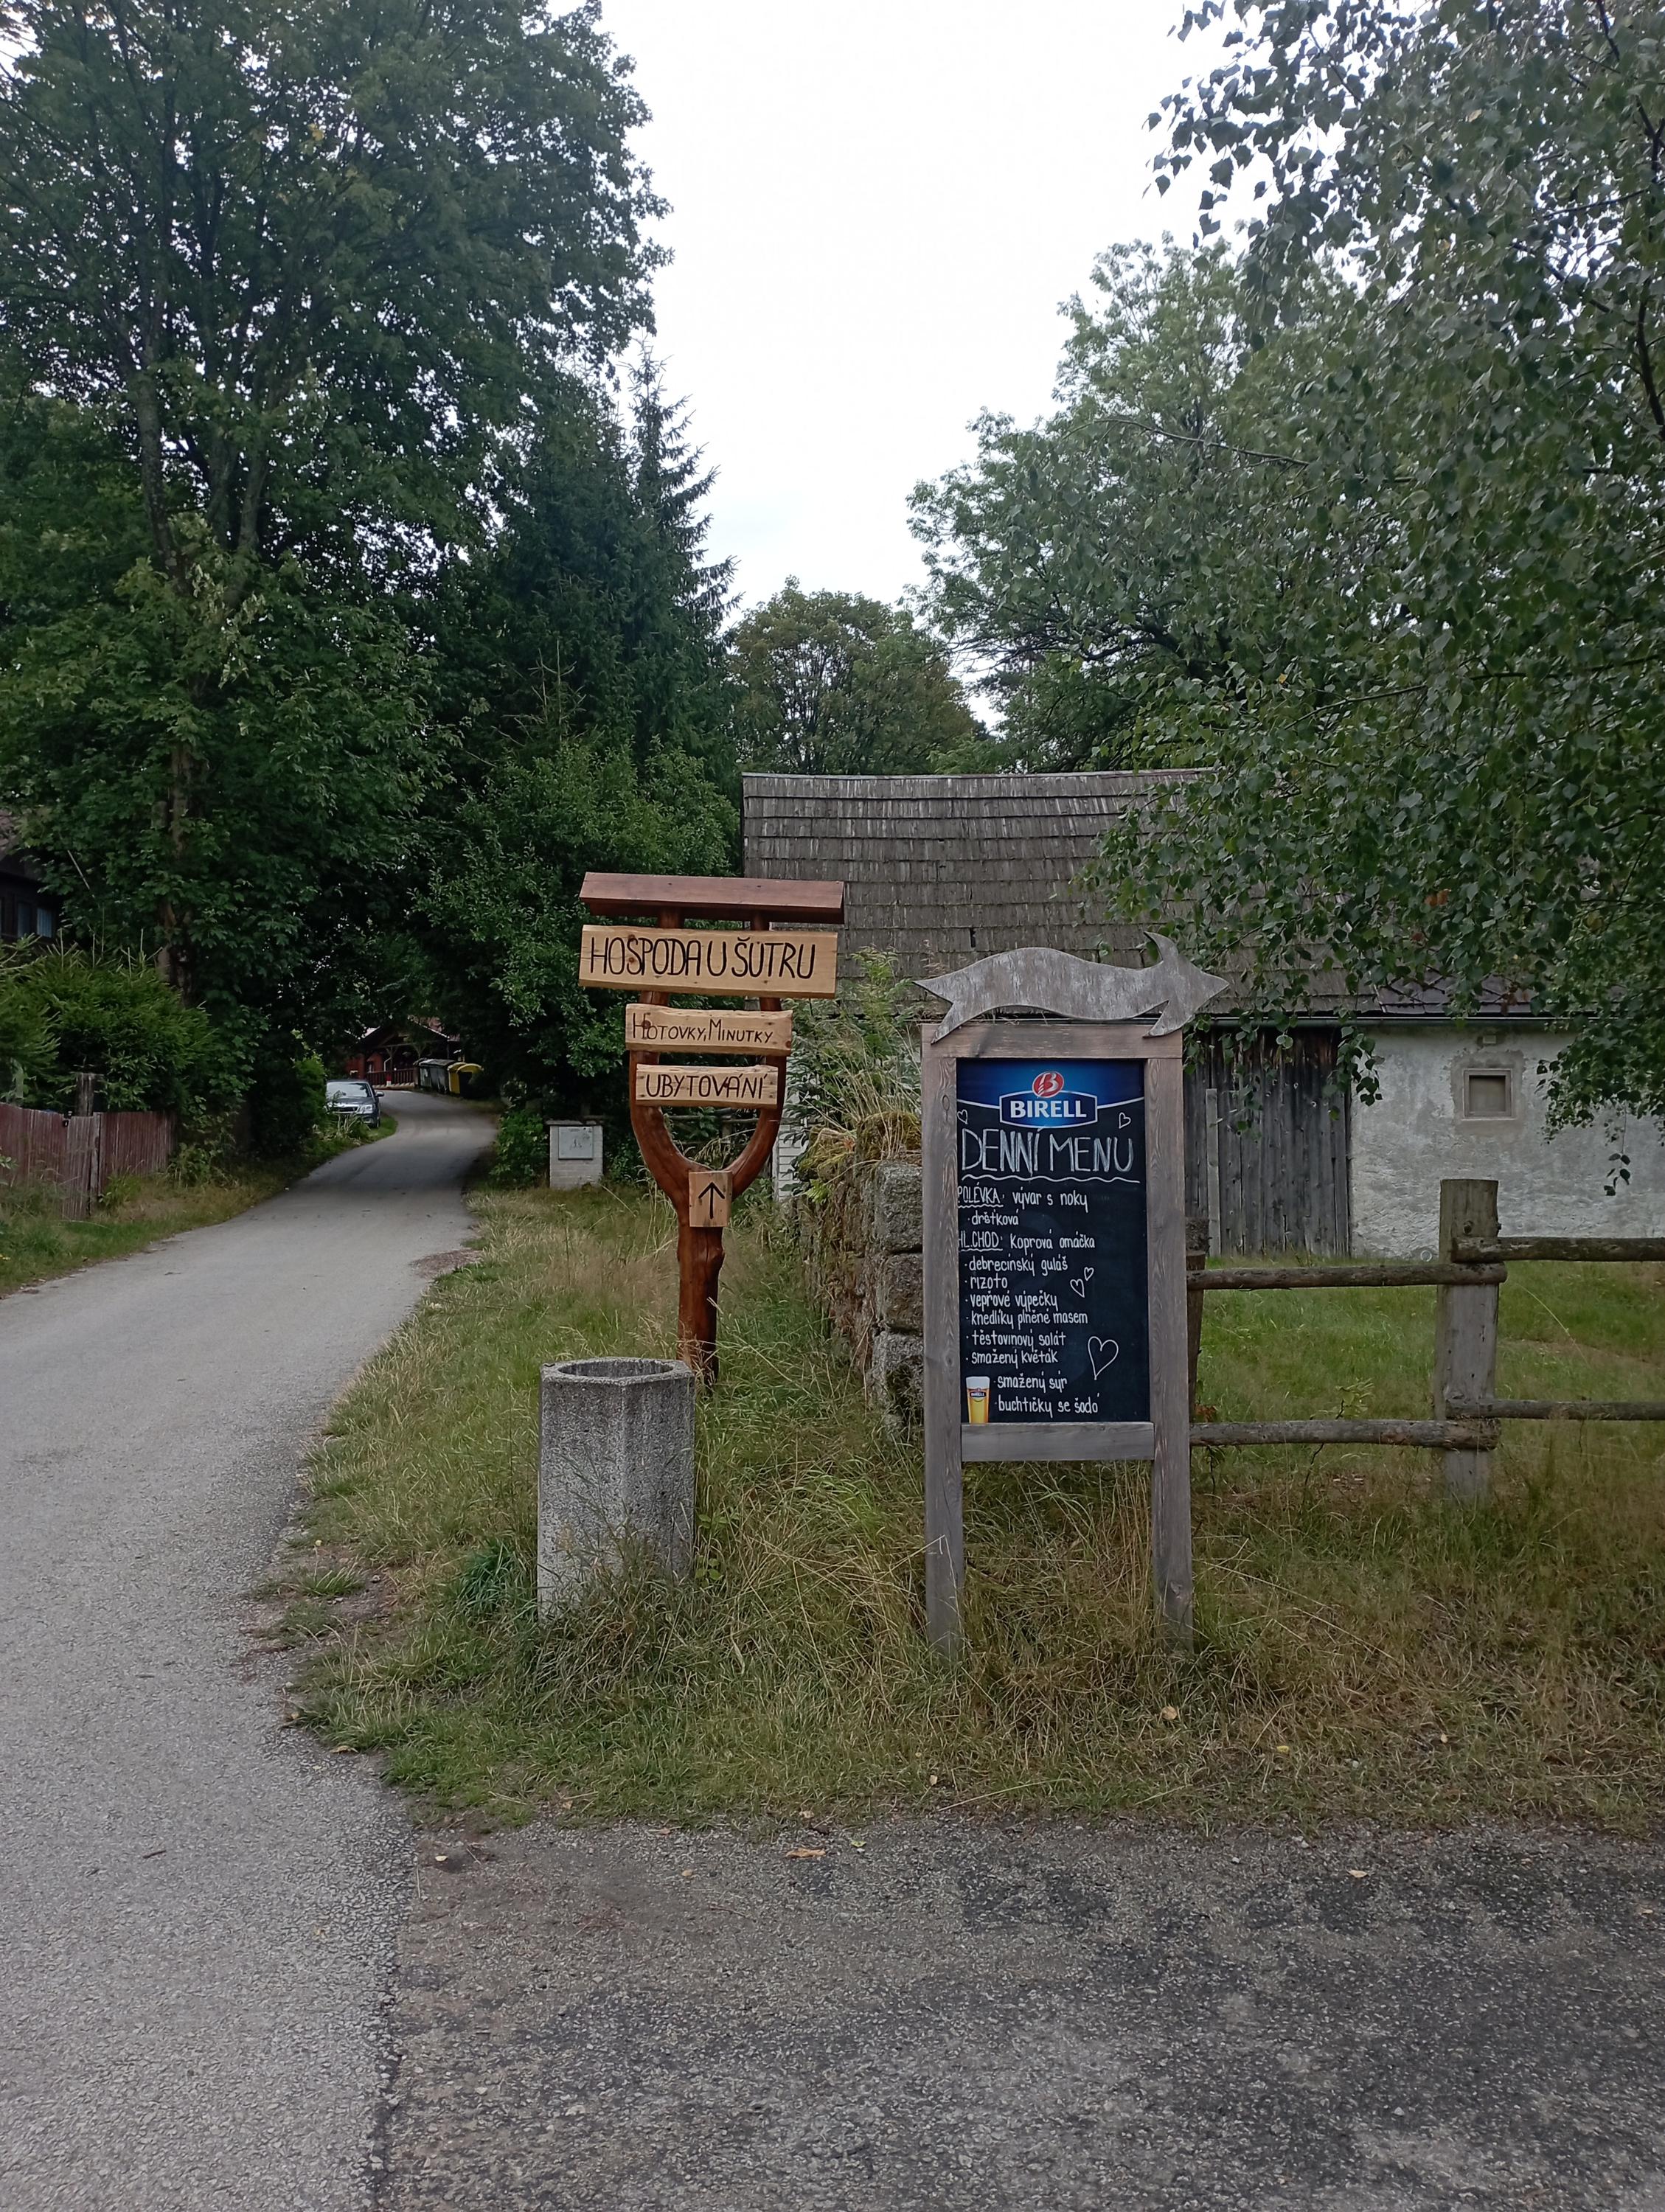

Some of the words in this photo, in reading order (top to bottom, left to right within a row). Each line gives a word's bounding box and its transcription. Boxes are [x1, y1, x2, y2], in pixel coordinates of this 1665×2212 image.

[591, 936, 701, 975] HOSPODA
[706, 940, 726, 977] U
[731, 936, 816, 979] ŠUTRU
[708, 1018, 774, 1043] MINUTKY
[646, 1074, 768, 1099] UBYTOVÁNÍ
[1010, 1100, 1087, 1119] BIRELL
[1050, 1133, 1134, 1173] MENU
[1012, 1186, 1042, 1209] vývar
[1047, 1193, 1054, 1206] s
[1060, 1189, 1089, 1213] noky
[1059, 1231, 1096, 1248] omáčka
[1040, 1254, 1068, 1276] guláš
[970, 1273, 1008, 1289] rizoto
[970, 1290, 1011, 1312] vepřové
[1015, 1290, 1059, 1312] výpečky
[971, 1309, 1014, 1329] knedlíky
[1018, 1308, 1051, 1330] plněné
[1053, 1312, 1088, 1324] masem
[971, 1329, 1034, 1353] těstovinový
[1038, 1330, 1066, 1346] salát
[971, 1349, 1018, 1369] smažený
[1021, 1348, 1059, 1364] květák
[997, 1370, 1046, 1394] smažený
[1049, 1370, 1068, 1393] sýr
[998, 1394, 1053, 1418] buchtičky
[1057, 1403, 1071, 1413] se
